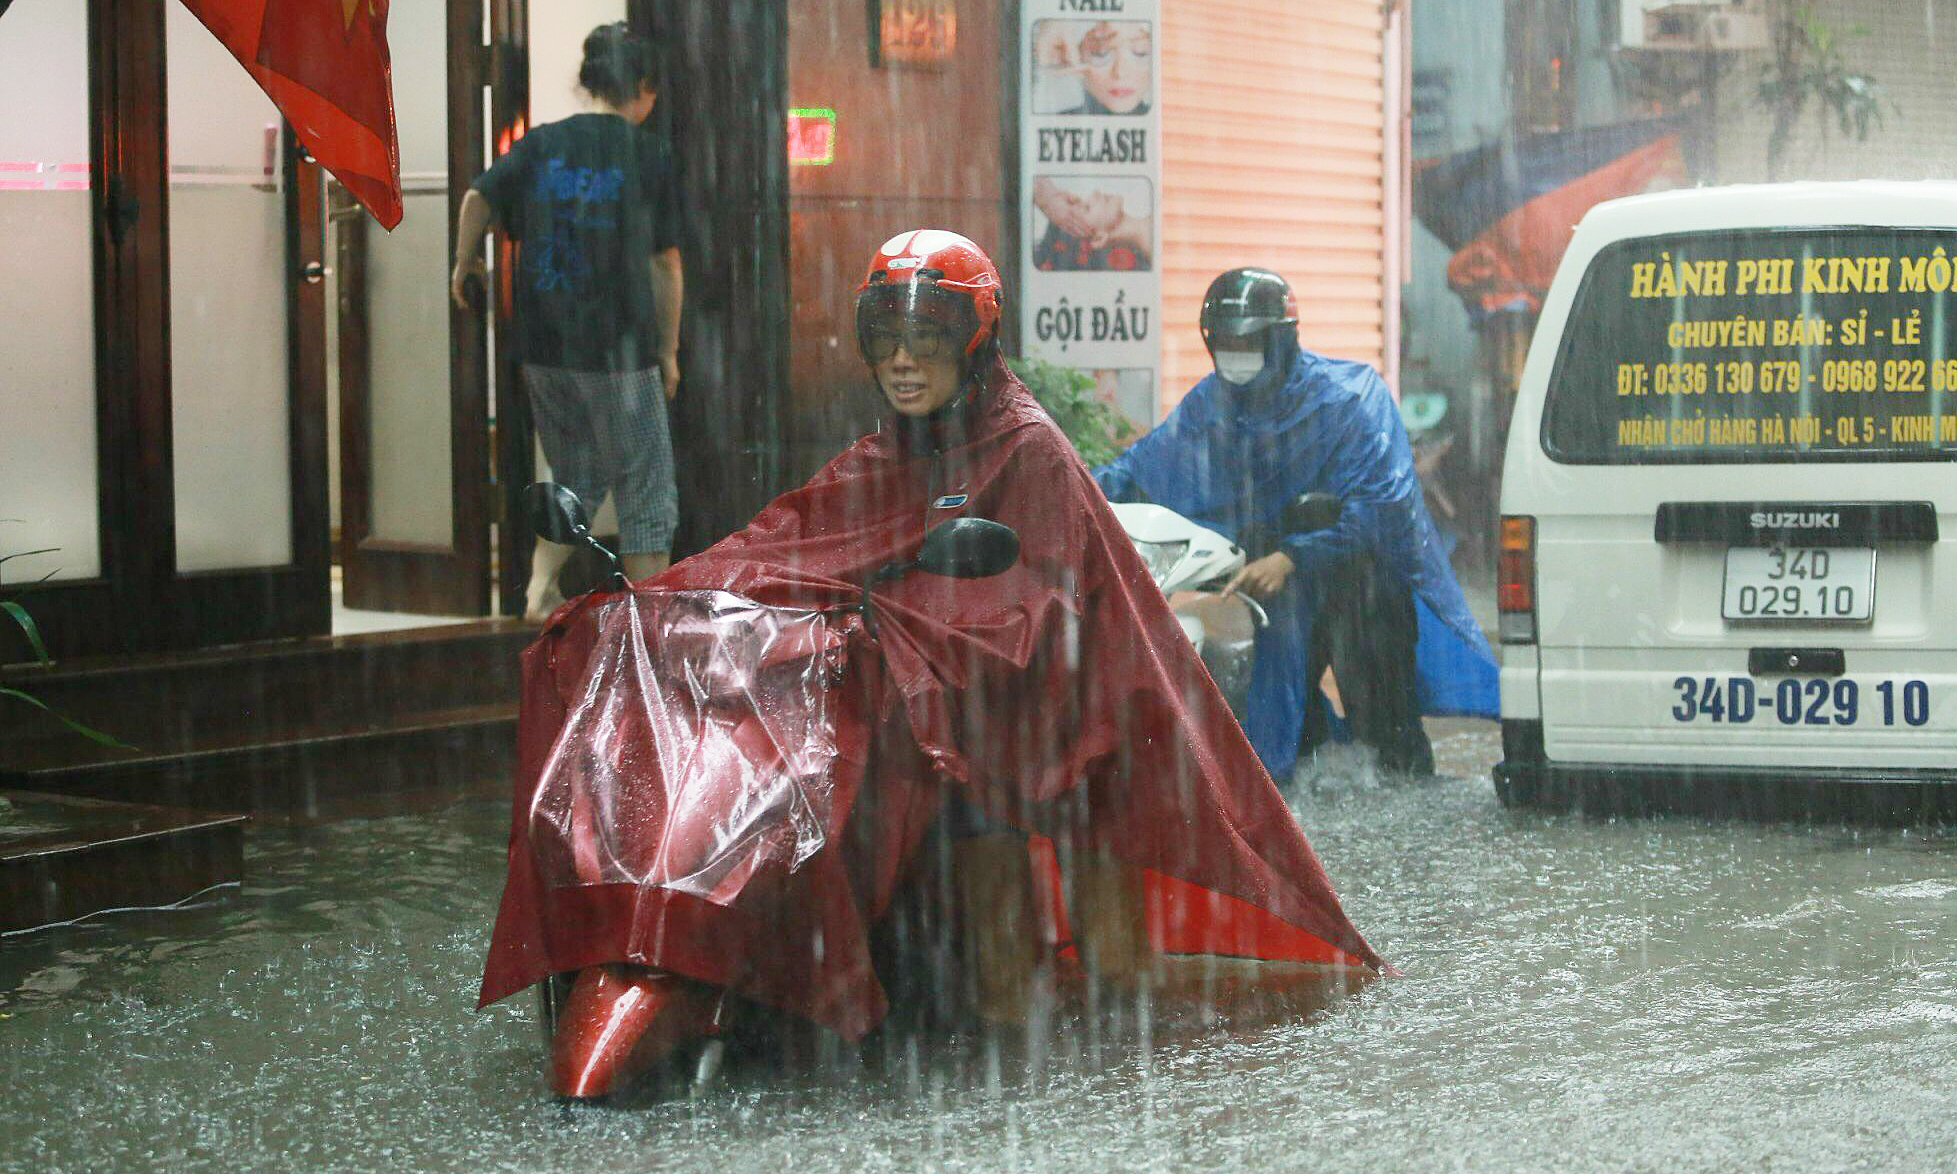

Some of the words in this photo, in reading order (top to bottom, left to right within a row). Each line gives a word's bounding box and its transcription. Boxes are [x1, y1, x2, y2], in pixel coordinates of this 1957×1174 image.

[1038, 128, 1147, 163] EYELASH
[1630, 251, 1728, 298] HÀNH
[1735, 259, 1794, 295] PHI
[1802, 256, 1891, 294] KINH
[1899, 246, 1957, 293] MÔ
[1036, 296, 1083, 352] GỘI
[1668, 314, 1766, 349] CHUYÊN
[1773, 313, 1833, 347] BÁN:
[1840, 308, 1868, 346] SỈ
[1892, 308, 1921, 346] LẺ
[1617, 363, 1649, 396] ĐT:
[1654, 362, 1708, 395] 0336
[1715, 361, 1754, 394] 130
[1760, 360, 1801, 393] 679
[1823, 359, 1878, 393] 0968
[1883, 359, 1926, 393] 922
[1618, 414, 1666, 450] NHẬN
[1709, 413, 1757, 446] HÀNG
[1762, 412, 1785, 446] HÀ
[1789, 412, 1821, 449] NỘI
[1837, 416, 1859, 446] QL
[1863, 416, 1875, 443] 5
[1891, 415, 1935, 443] KINH
[1750, 512, 1840, 528] SUZUKI
[1768, 547, 1830, 580] 34D
[1739, 585, 1853, 616] 029.10
[1672, 676, 1859, 726] 34D-029
[1876, 680, 1930, 726] 10
